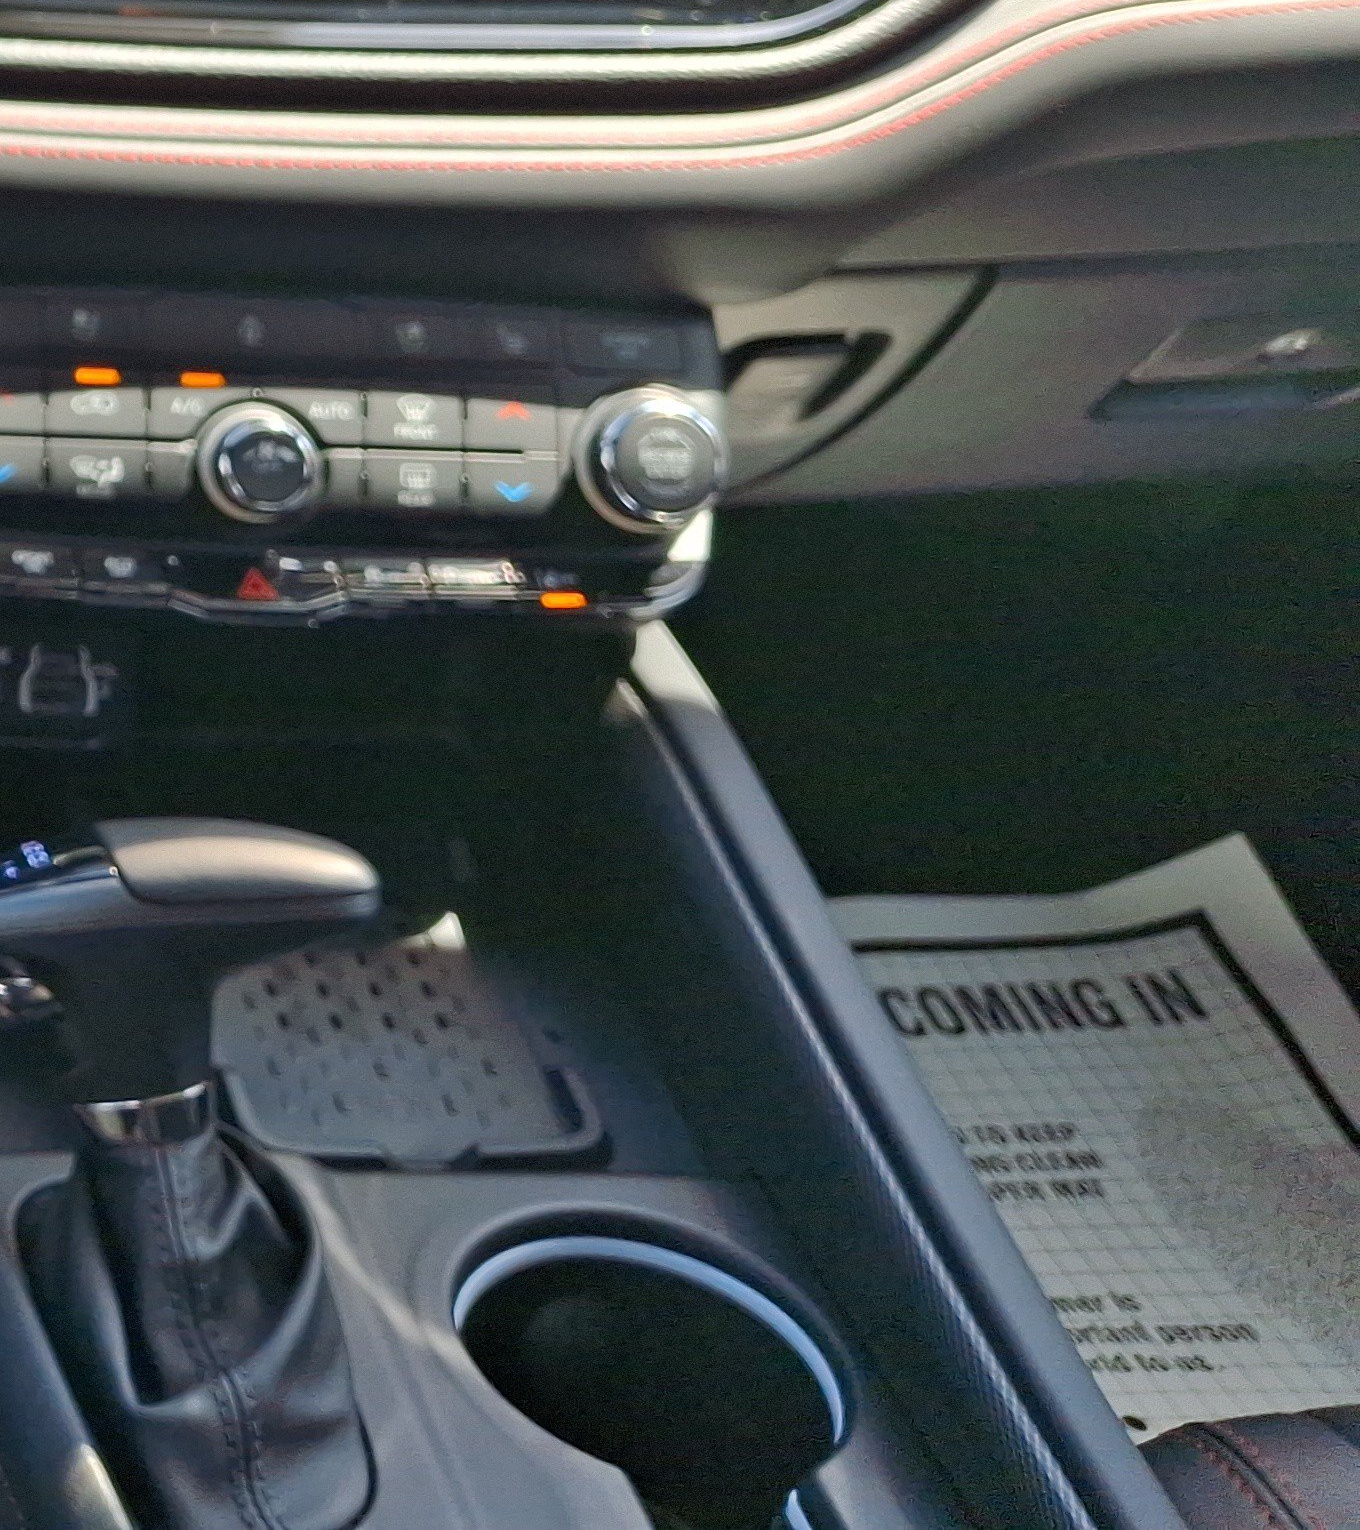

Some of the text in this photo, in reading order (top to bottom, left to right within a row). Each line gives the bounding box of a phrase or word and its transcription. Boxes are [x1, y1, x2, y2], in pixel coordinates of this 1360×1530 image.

[307, 401, 356, 423] AUTO
[879, 967, 1210, 1039] COMING IN
[1153, 1323, 1261, 1347] person
